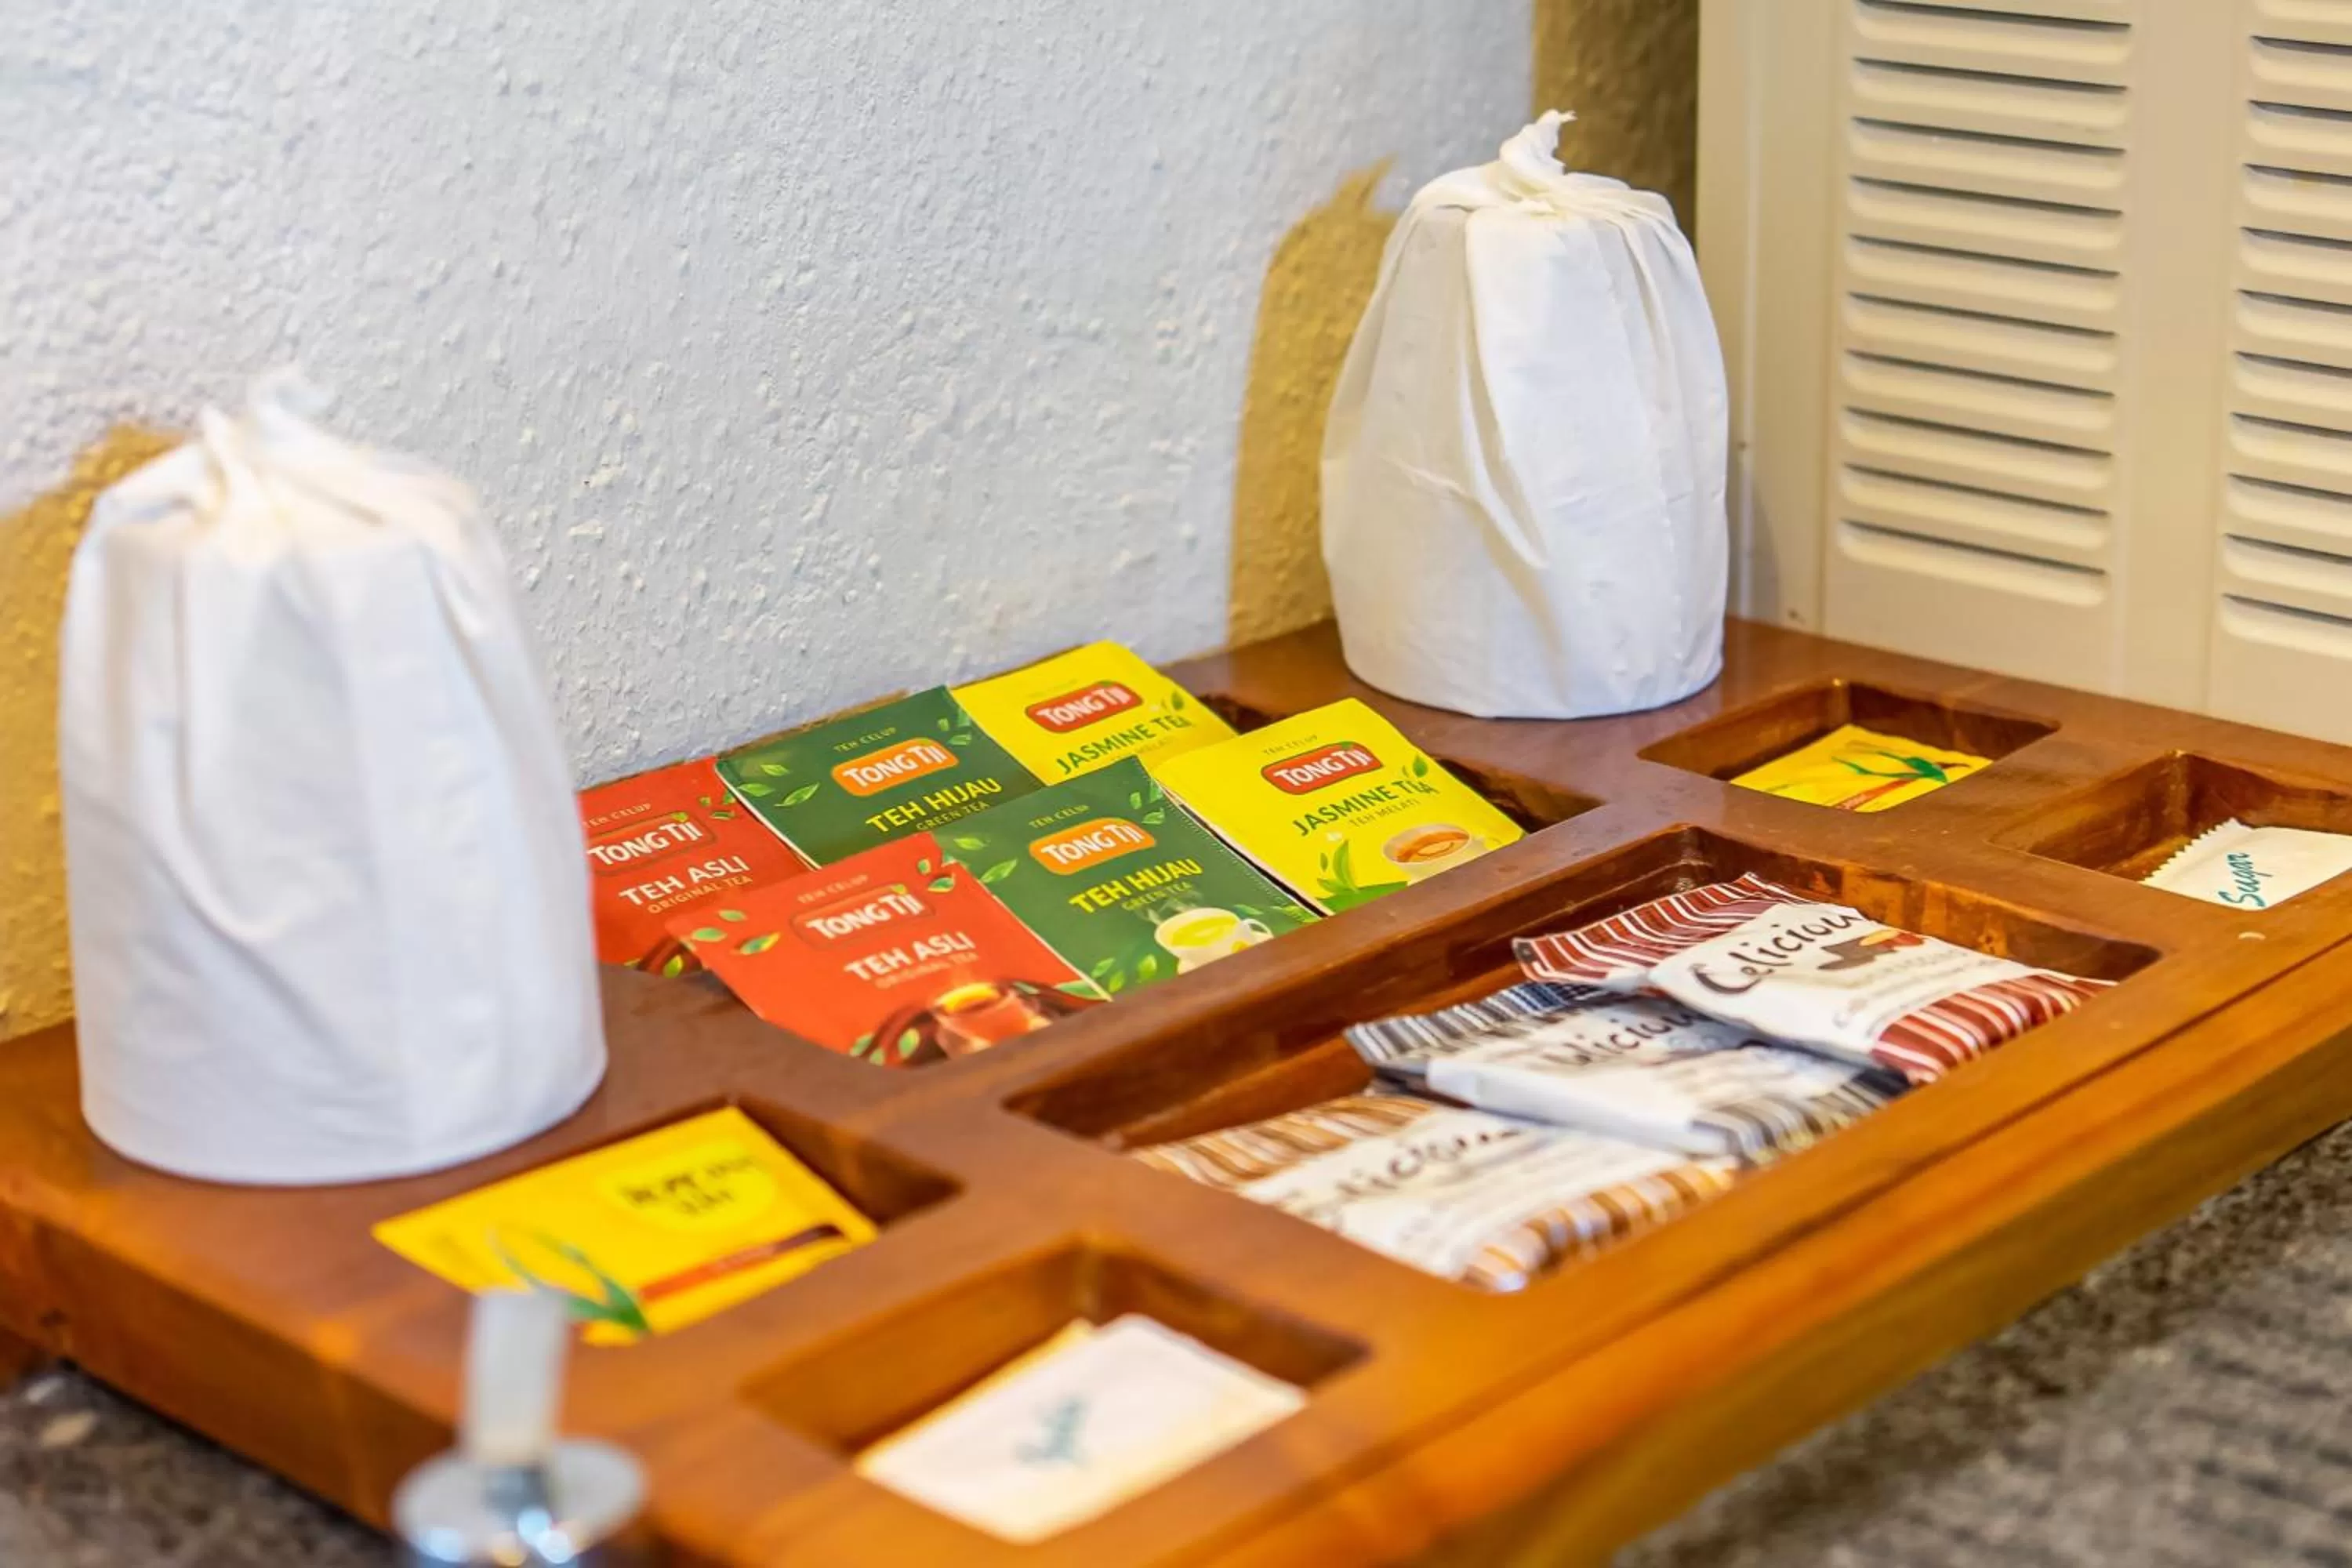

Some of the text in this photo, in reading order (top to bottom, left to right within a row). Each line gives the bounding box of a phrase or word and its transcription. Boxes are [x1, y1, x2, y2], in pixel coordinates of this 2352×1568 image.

[1036, 695, 1105, 725] TONG
[1057, 724, 1156, 775] JASMINE
[842, 753, 918, 787] TONG
[1273, 757, 1345, 786] TONG
[866, 778, 1002, 832] TEH HIJAU
[916, 800, 990, 830] GREEN TEA
[1292, 786, 1399, 837] JASMINE
[586, 831, 670, 865] TONG
[1040, 831, 1116, 865] TONG
[619, 856, 750, 905] TEH ASLI
[648, 876, 753, 913] ORIGINAL TEA
[1069, 858, 1203, 913] TEH HIJAU
[2218, 853, 2274, 906] Sugar
[805, 903, 891, 939] TONG
[844, 931, 975, 980] TEH ASLI
